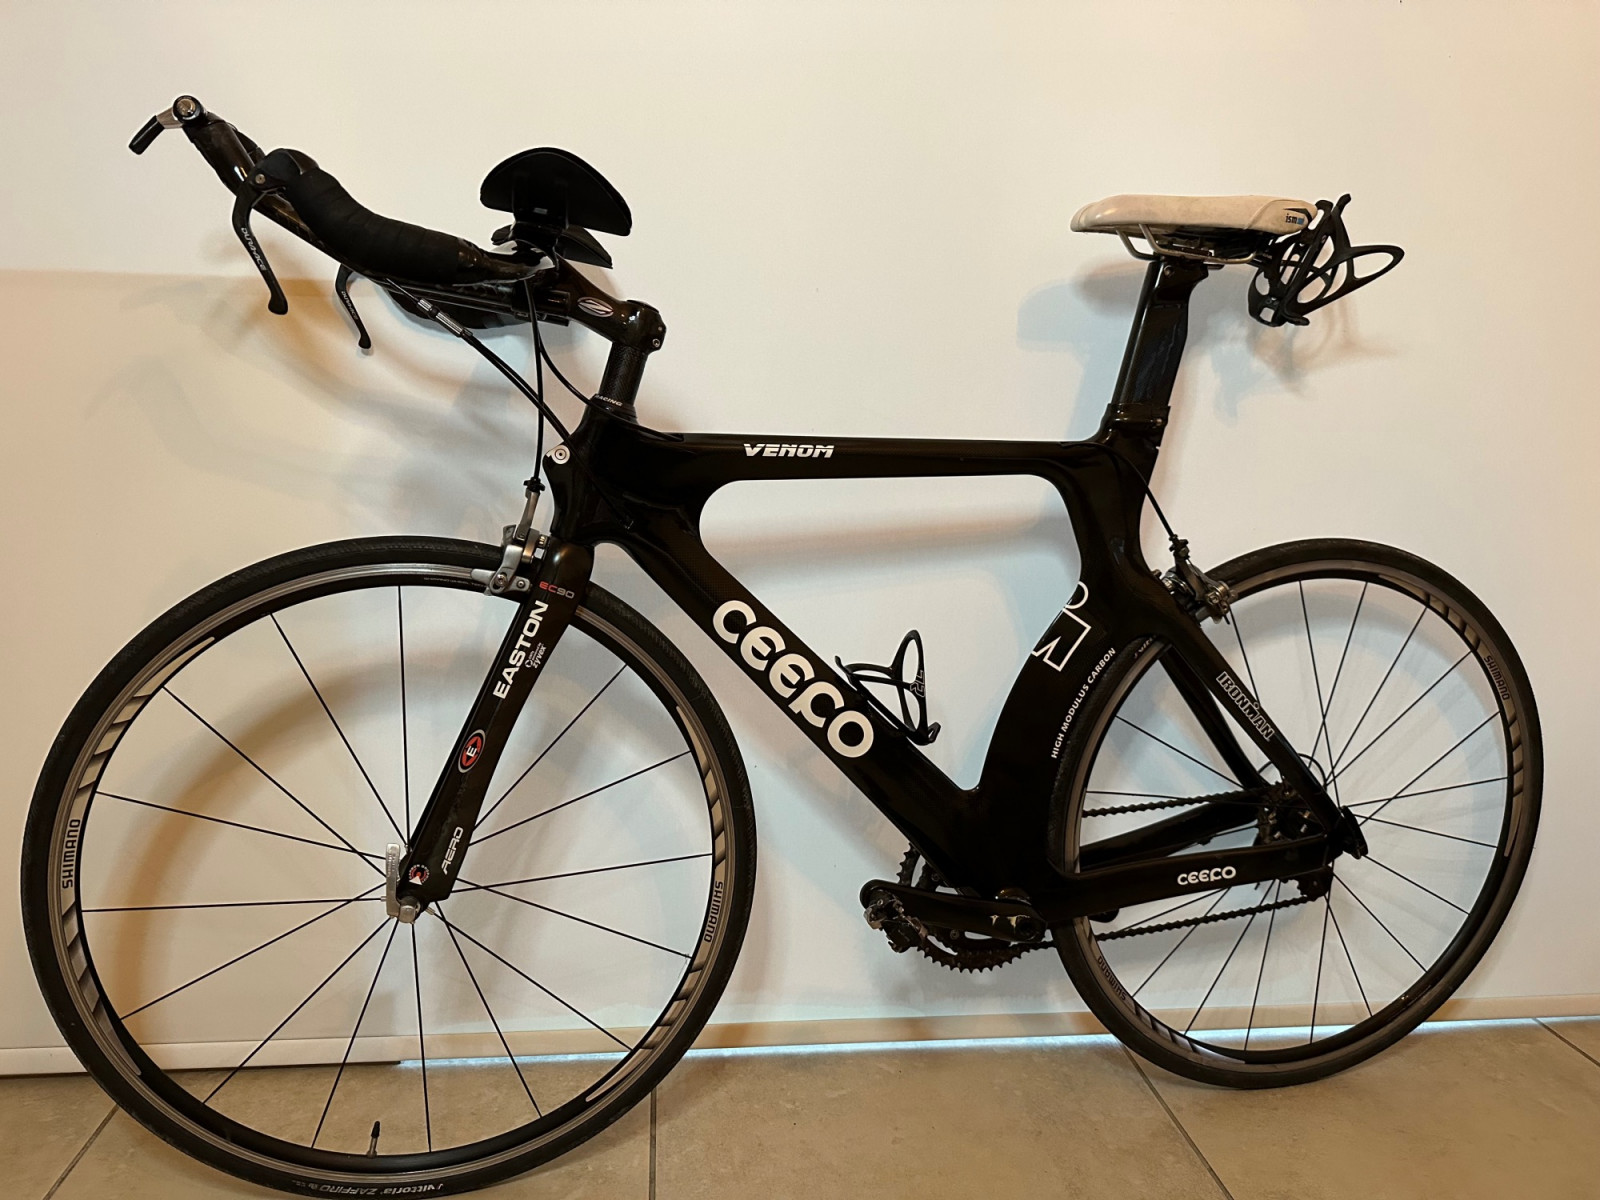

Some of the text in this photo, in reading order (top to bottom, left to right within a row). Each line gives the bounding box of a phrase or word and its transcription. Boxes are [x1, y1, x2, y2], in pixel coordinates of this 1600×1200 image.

[743, 443, 835, 458] VENOM
[539, 580, 575, 599] EC90
[492, 600, 549, 699] EASTON
[1483, 655, 1510, 701] SHIMANO
[1051, 647, 1116, 759] HIGH MODULUS CARBON
[1216, 671, 1275, 742] IRONMAN
[61, 818, 81, 889] SHIMANO
[441, 826, 464, 875] AERO
[704, 881, 724, 943] SHIMANO
[1097, 955, 1128, 1001] SHIMANO
[319, 1184, 378, 1196] ZAFFIRO
